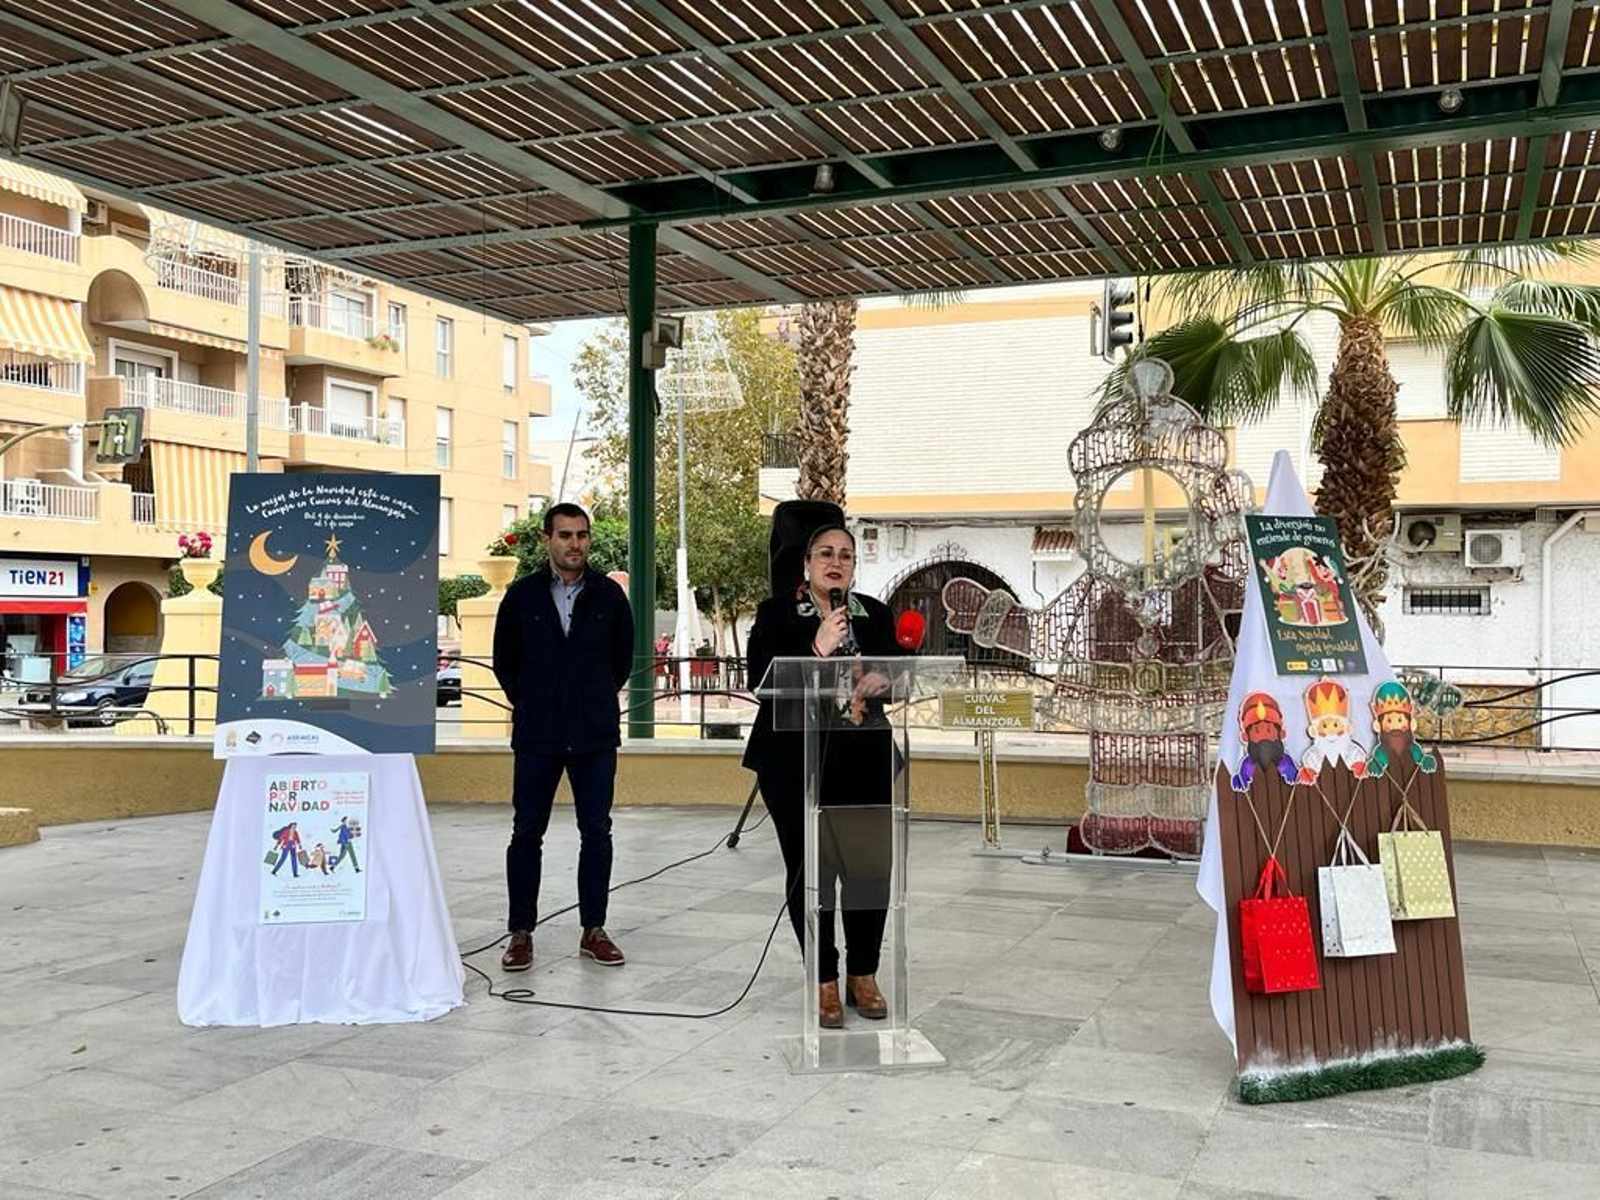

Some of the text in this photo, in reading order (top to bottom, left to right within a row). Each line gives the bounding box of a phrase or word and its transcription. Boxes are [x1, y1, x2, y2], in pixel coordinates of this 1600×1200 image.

[316, 484, 356, 496] Navidad
[309, 496, 342, 506] Cuevas
[344, 496, 360, 506] del
[360, 498, 406, 519] Almanzora
[1273, 517, 1313, 531] diversión
[1255, 530, 1291, 546] entiende
[1291, 530, 1302, 541] de
[964, 694, 1006, 704] CUEVAS
[975, 706, 996, 715] DEL
[952, 716, 1022, 726] ALMANZORA
[269, 780, 327, 791] ABIERTO
[269, 792, 298, 801] POR
[268, 801, 331, 813] NAVIDAD
